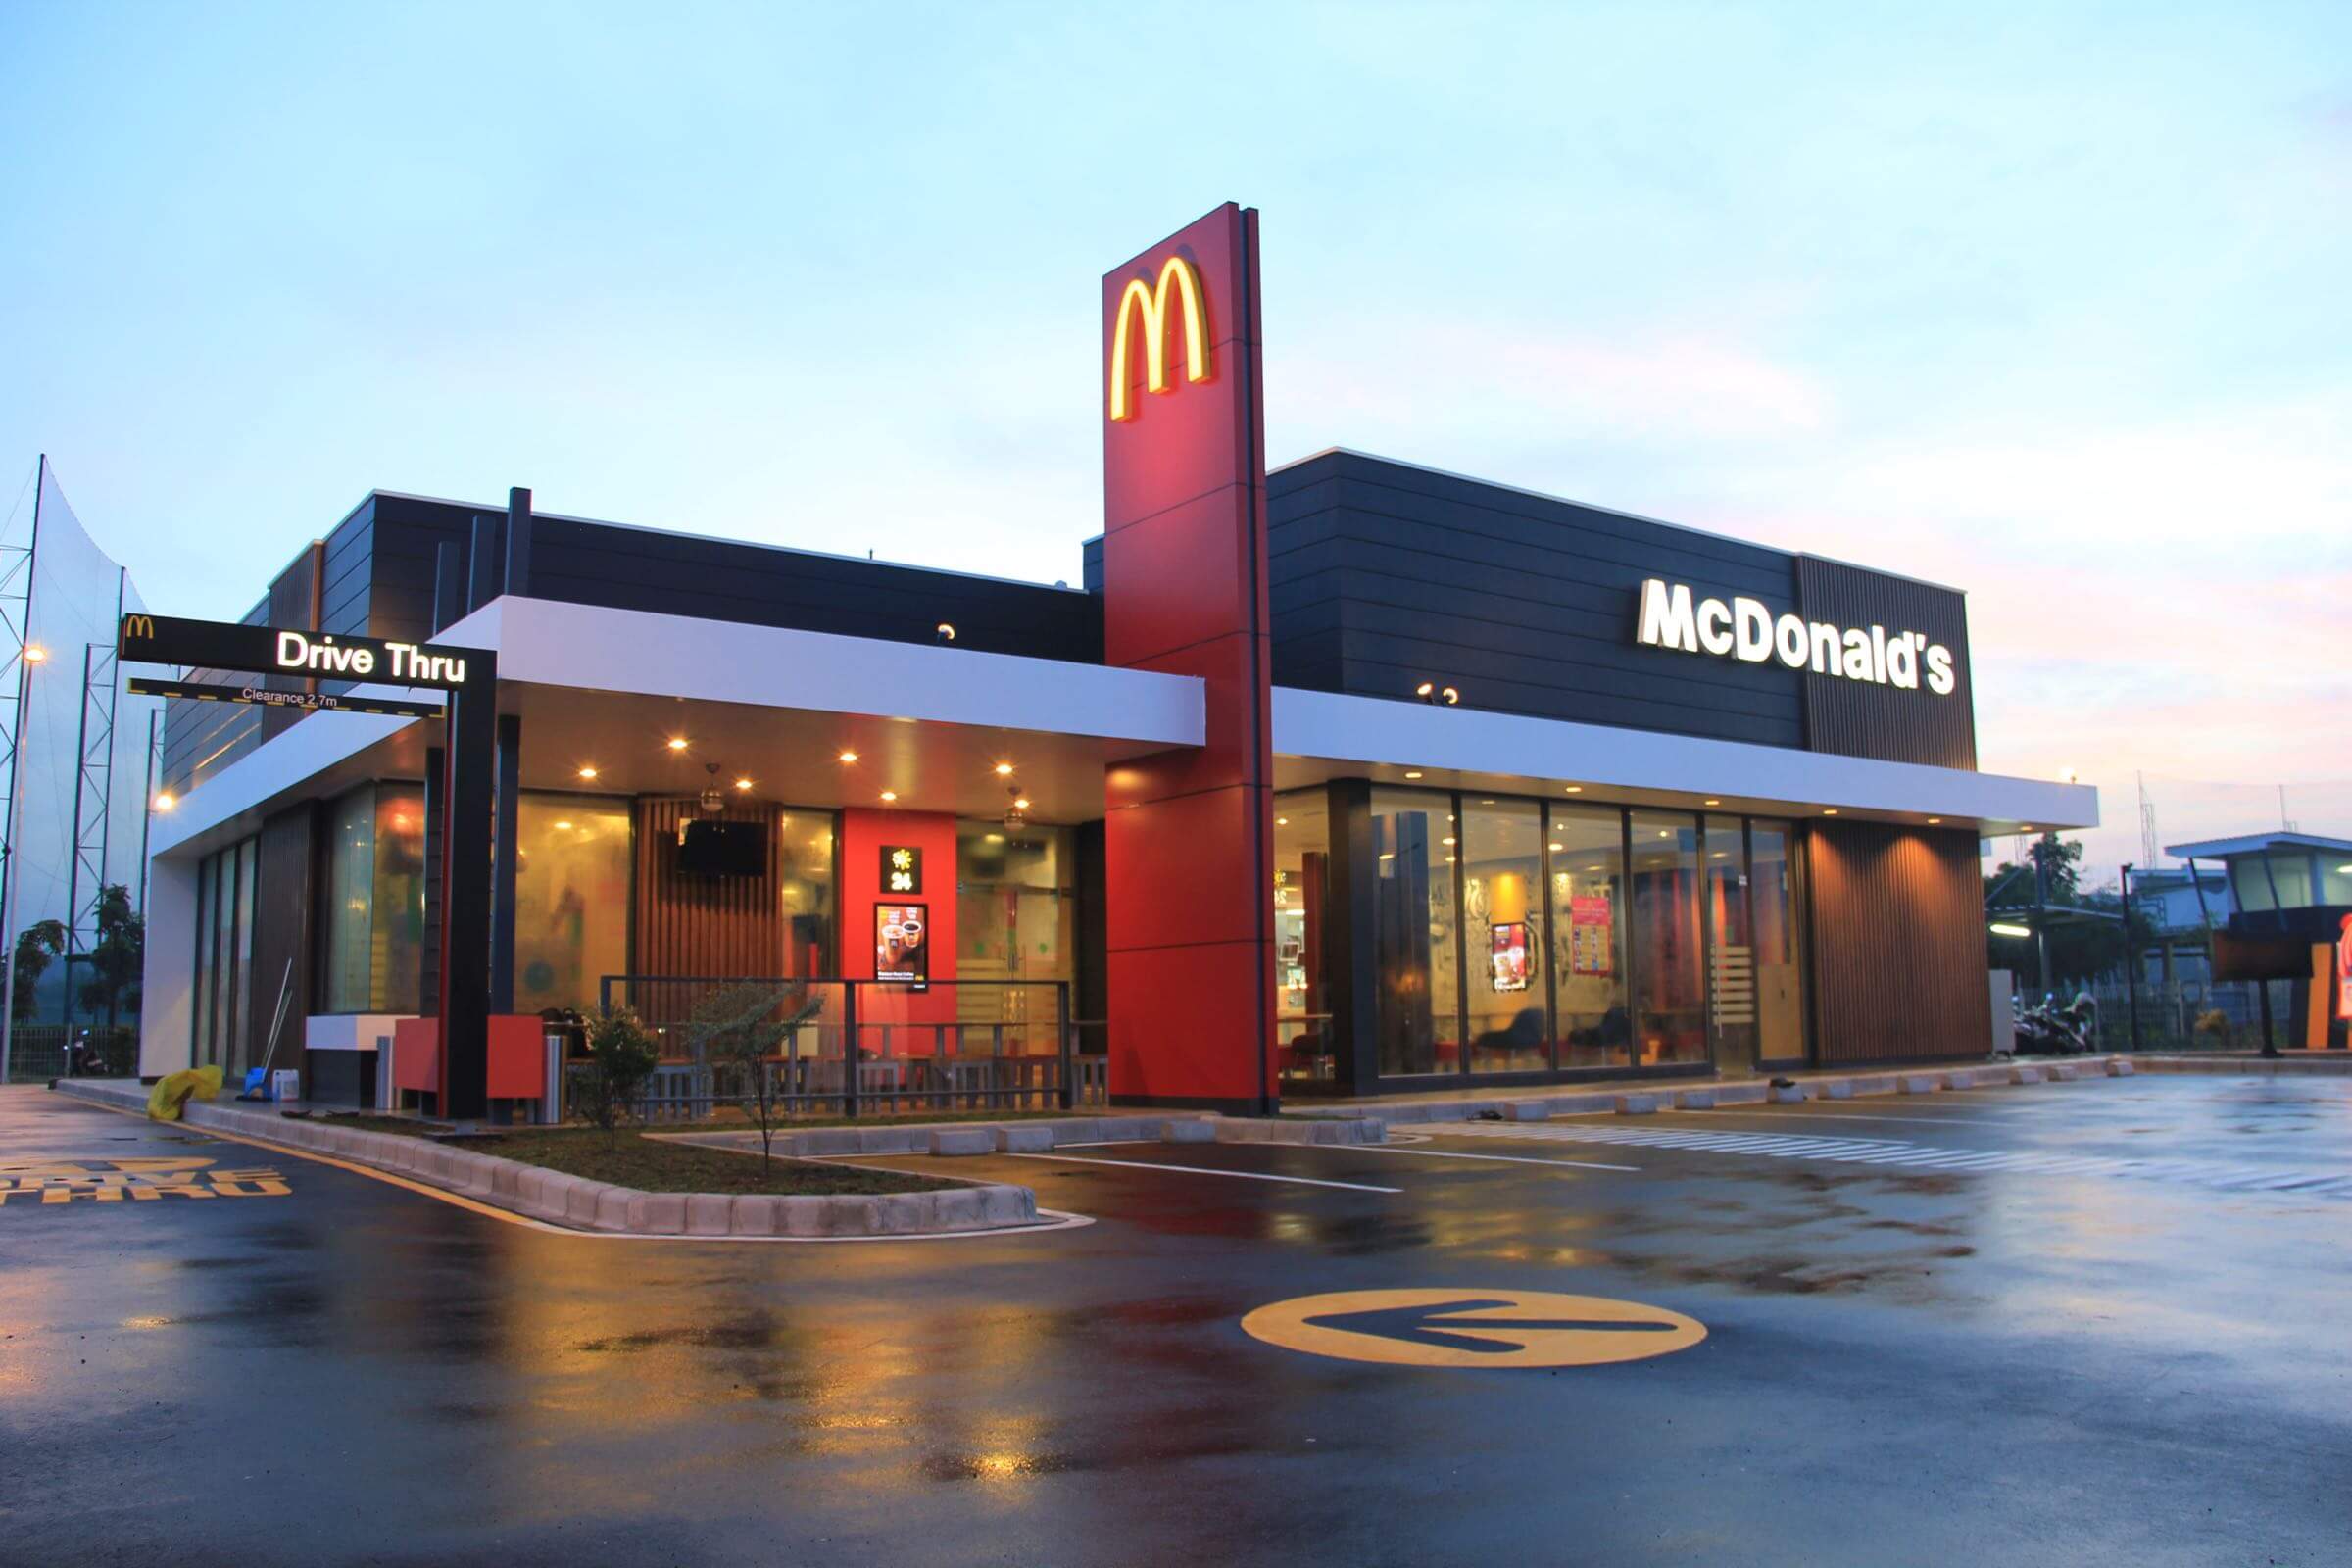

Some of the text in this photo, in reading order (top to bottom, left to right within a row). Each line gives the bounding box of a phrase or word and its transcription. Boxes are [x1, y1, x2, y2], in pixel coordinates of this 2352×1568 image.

[1637, 578, 1955, 695] McDonald's
[276, 631, 466, 683] Drive Thru
[242, 688, 305, 704] Clearance
[891, 871, 913, 891] 24
[0, 1168, 286, 1189] RIVE
